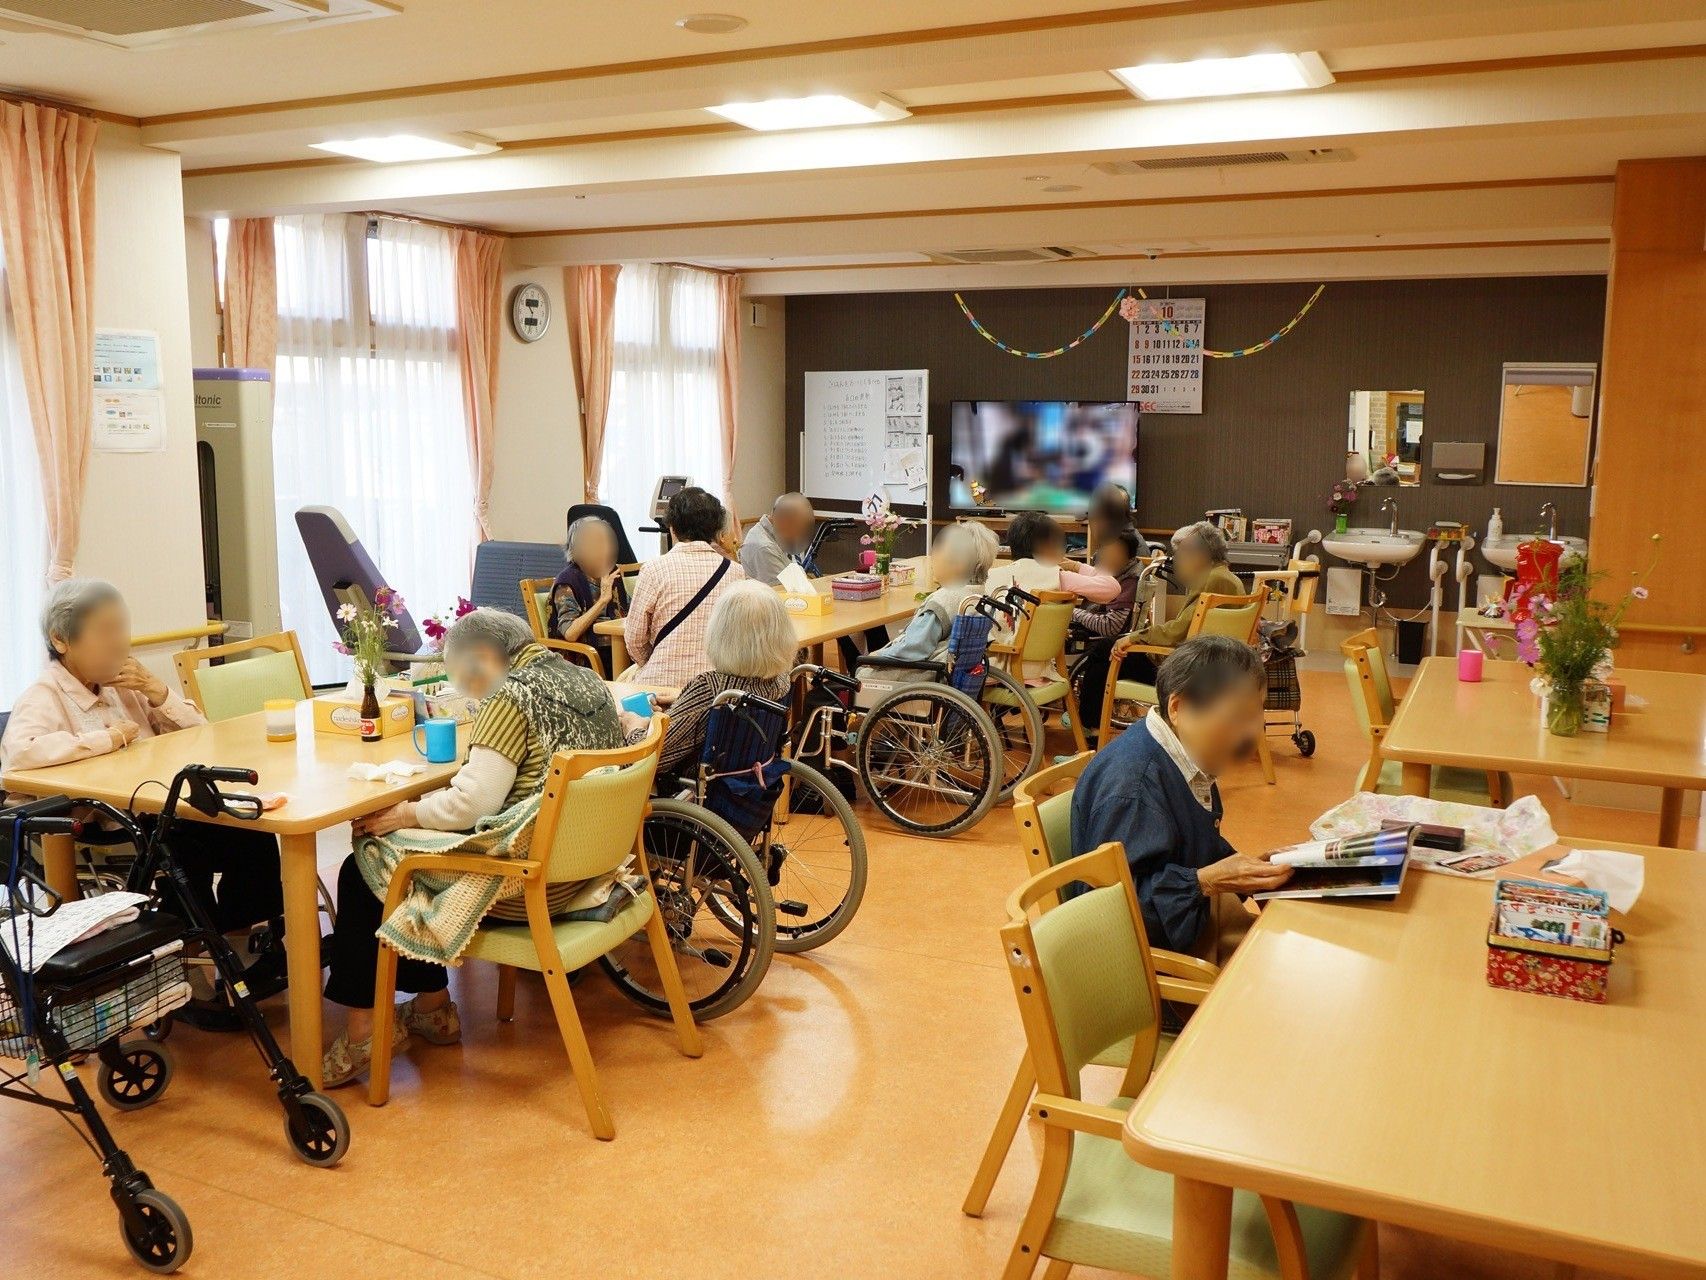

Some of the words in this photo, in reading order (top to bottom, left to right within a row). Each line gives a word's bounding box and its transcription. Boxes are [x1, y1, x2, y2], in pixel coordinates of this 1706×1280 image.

[1162, 306, 1174, 318] 10
[1145, 324, 1149, 334] 2
[1155, 324, 1159, 334] 3
[1184, 324, 1189, 334] 6
[1135, 340, 1139, 349] 8
[1144, 340, 1149, 349] 9
[1153, 340, 1160, 349] 10
[1163, 340, 1170, 349] 11
[1173, 340, 1180, 349] 12
[1133, 355, 1140, 363] 15
[1143, 355, 1150, 363] 16
[1152, 355, 1160, 363] 17
[1162, 355, 1170, 363] 18
[1172, 355, 1180, 363] 19
[1181, 355, 1189, 363] 20
[1191, 355, 1199, 363] 21
[1132, 370, 1140, 379] 22
[1141, 370, 1150, 379] 23
[1151, 370, 1160, 379] 24
[1161, 370, 1169, 379] 25
[1171, 370, 1179, 379] 26
[1181, 370, 1189, 379] 27
[1190, 370, 1199, 379] 28
[1131, 385, 1140, 394] 29
[1141, 385, 1149, 394] 30
[1150, 385, 1159, 394] 31
